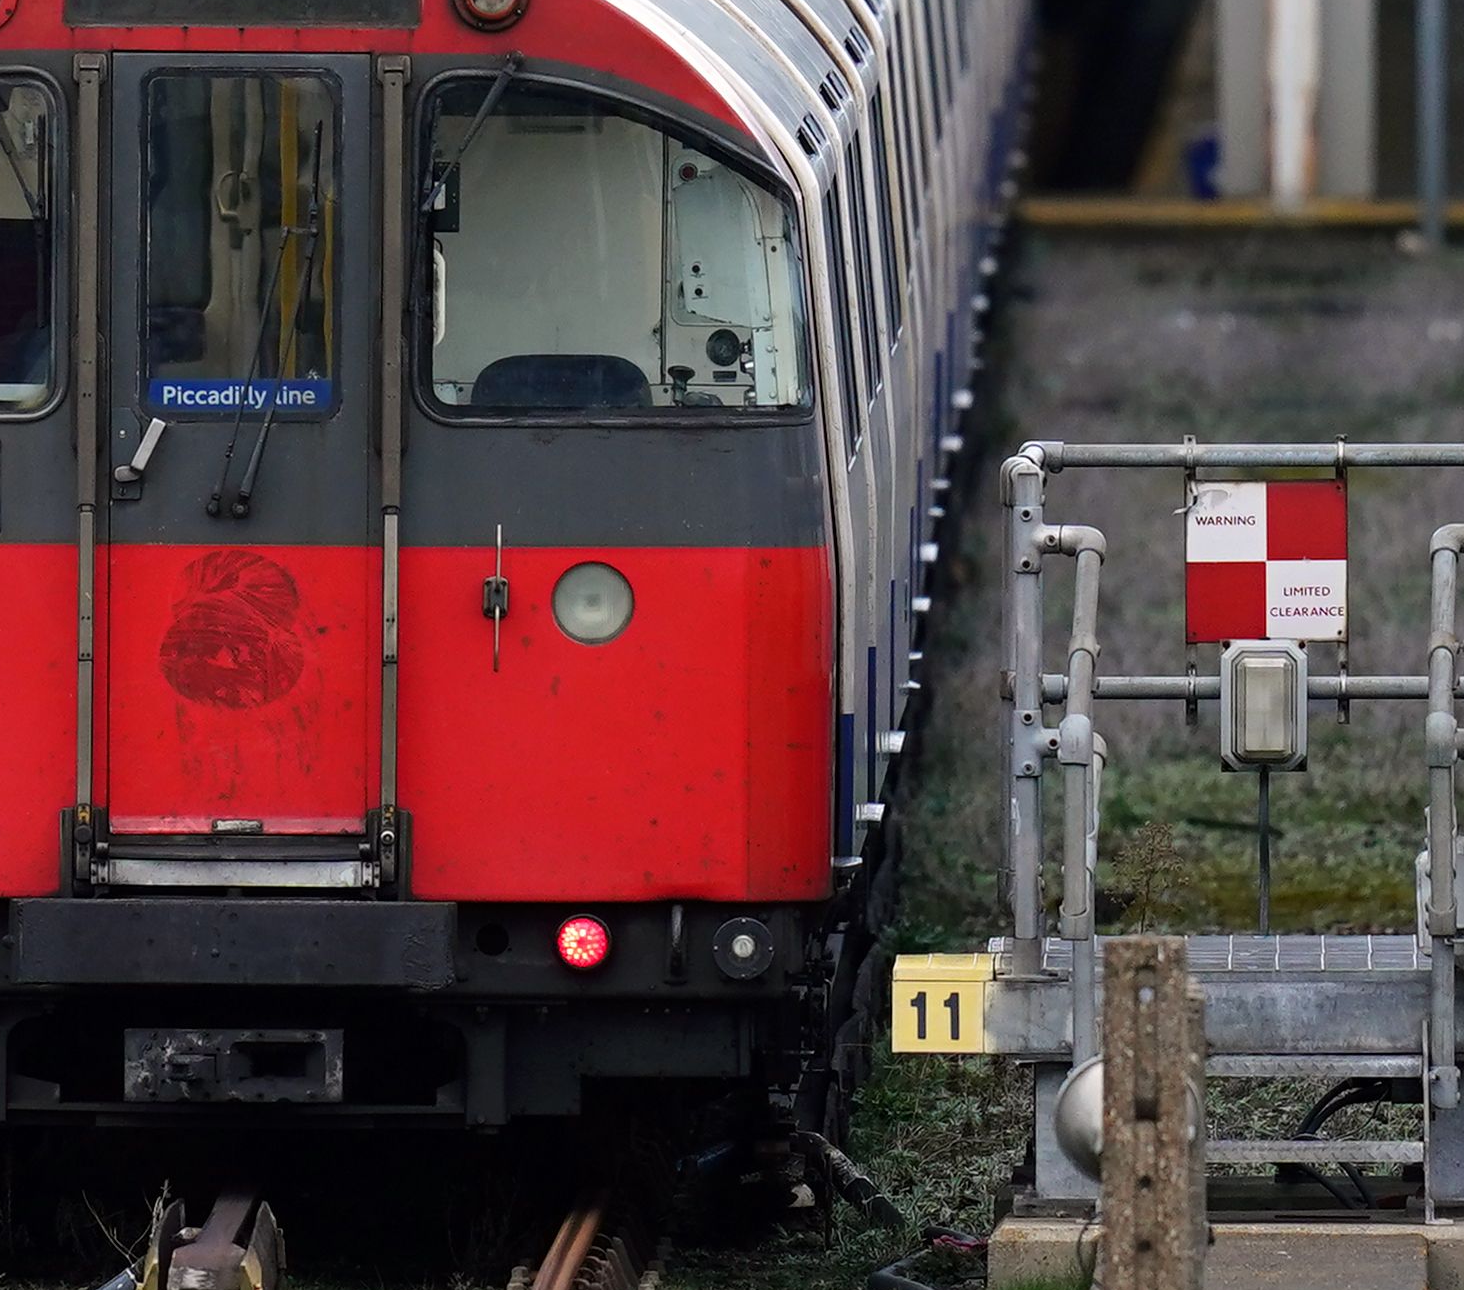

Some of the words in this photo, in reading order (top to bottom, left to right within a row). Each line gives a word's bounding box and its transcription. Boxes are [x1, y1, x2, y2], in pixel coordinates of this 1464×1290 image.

[1195, 515, 1256, 526] WARNING
[1283, 586, 1331, 597] LIMITED
[1269, 606, 1345, 617] CLEARANCE
[910, 991, 960, 1040] 11
